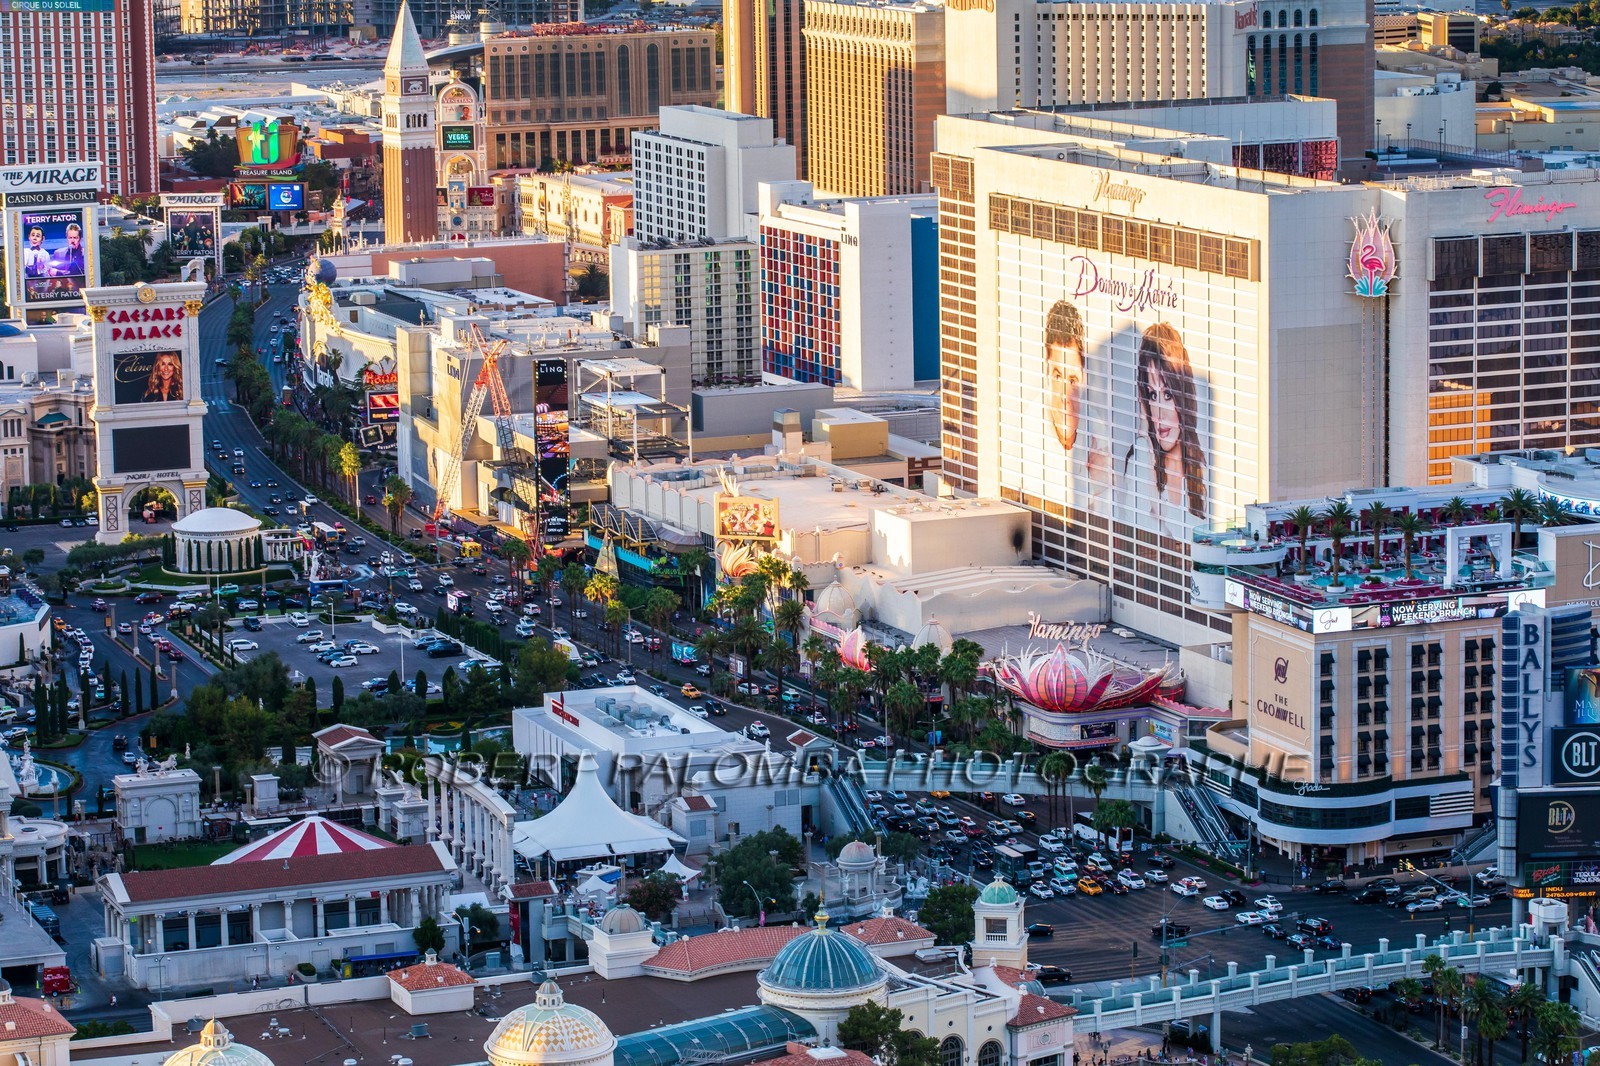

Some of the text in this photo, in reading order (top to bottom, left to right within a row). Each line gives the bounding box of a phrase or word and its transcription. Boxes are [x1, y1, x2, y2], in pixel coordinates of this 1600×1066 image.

[12, 1, 82, 11] CIRQUE DU SOLEIL
[447, 133, 470, 141] VEGAS
[3, 167, 98, 187] THE MIRAGE
[7, 191, 95, 204] CASINO & RESORT
[167, 195, 218, 205] MIRAGE
[1483, 186, 1577, 222] Flamingo
[25, 213, 77, 224] TERRY FATOR
[840, 233, 858, 247] LINQ
[1069, 255, 1129, 307] Donny
[36, 292, 59, 300] TERRY
[106, 306, 186, 325] CAESARS
[112, 323, 182, 342] PALACE
[114, 354, 154, 384] Celine
[126, 471, 181, 482] NOBU HOTEL
[1248, 589, 1283, 610] NOW SERVING
[1248, 598, 1273, 617] WEEKEND
[1392, 601, 1456, 615] NOW SERVING
[1392, 611, 1437, 622] WEEKEND
[1439, 606, 1477, 618] BRUNCH
[1027, 610, 1107, 651] Flamingo
[1274, 693, 1288, 707] THE
[1520, 623, 1543, 768] BALLYS
[1256, 699, 1306, 731] CROMWELL
[1572, 741, 1598, 767] BLT
[1293, 779, 1331, 796] Giada
[1548, 807, 1569, 826] BLT
